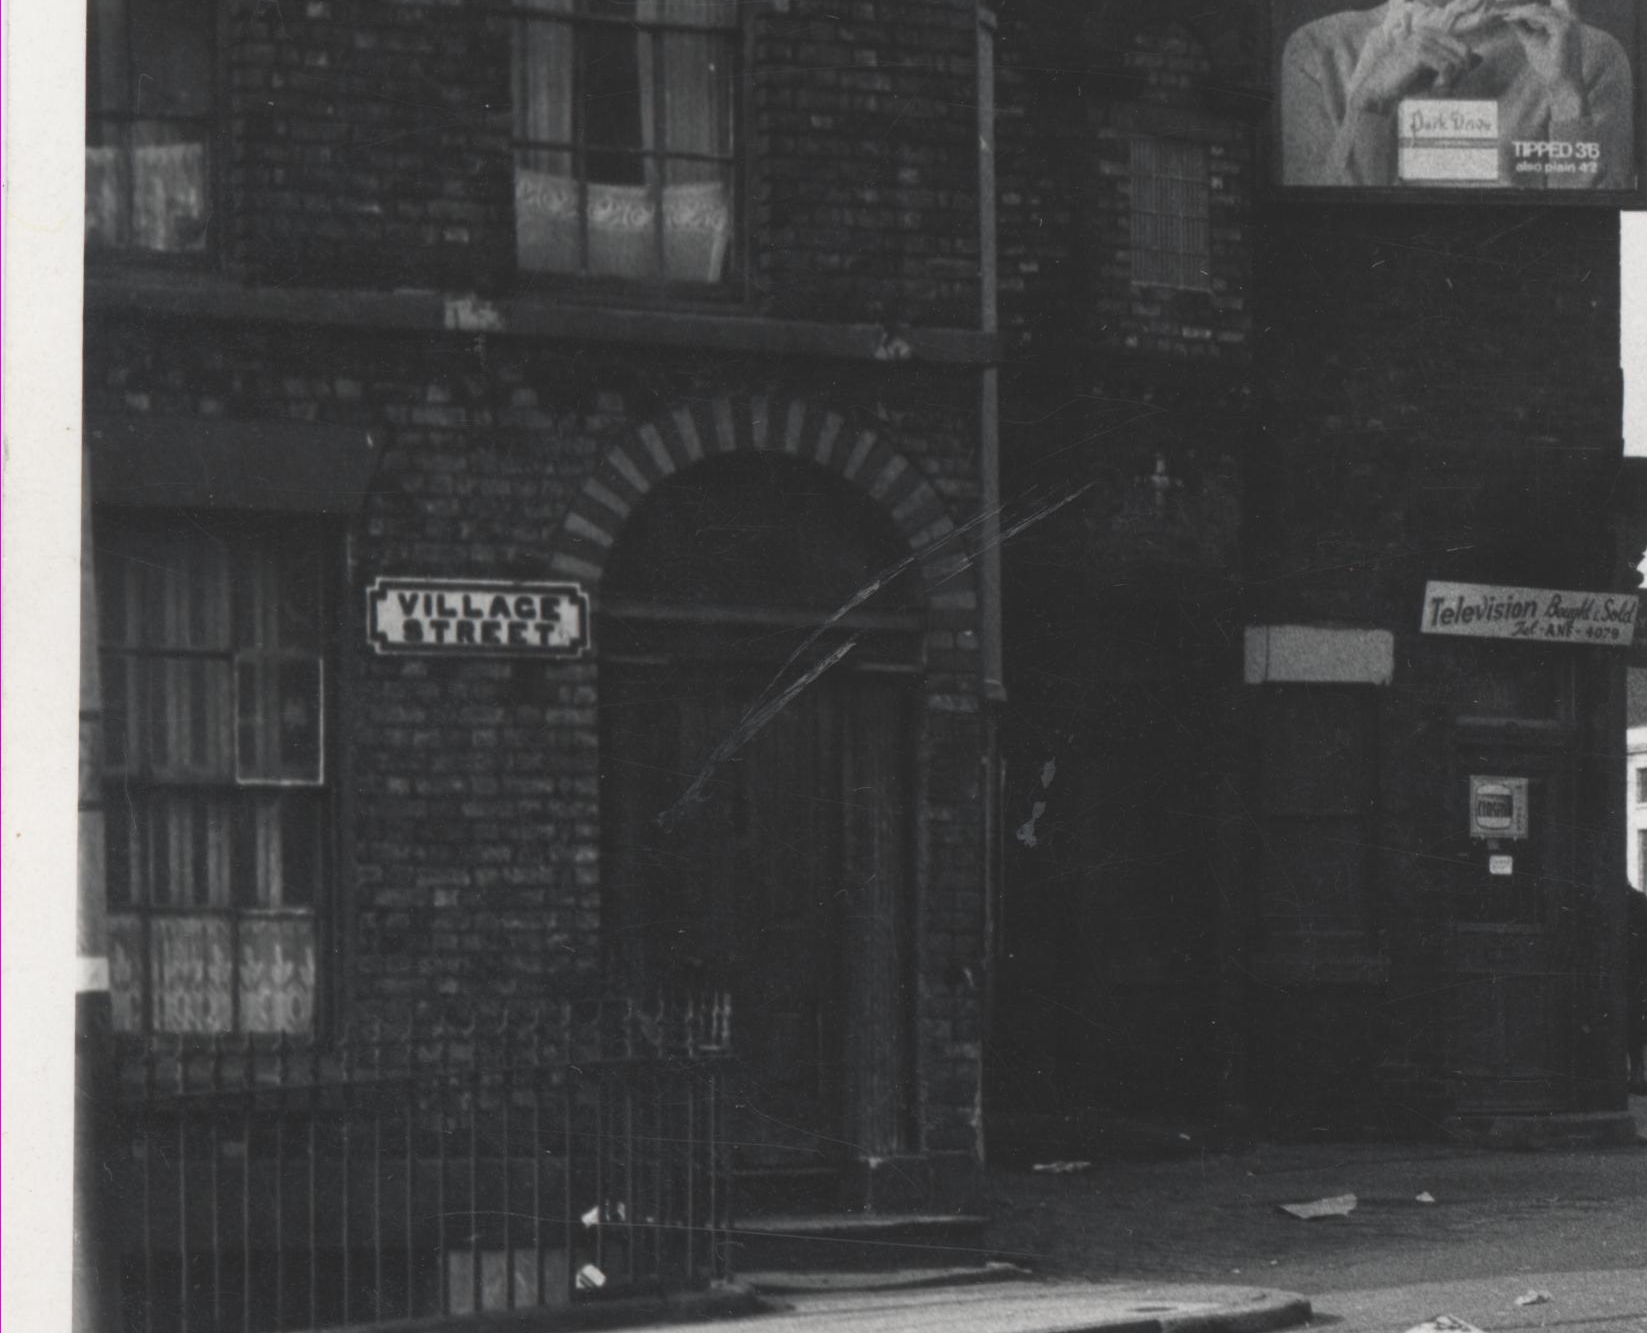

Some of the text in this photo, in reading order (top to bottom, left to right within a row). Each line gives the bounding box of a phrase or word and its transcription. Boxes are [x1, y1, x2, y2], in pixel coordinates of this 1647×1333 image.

[1511, 141, 1574, 158] TIPPED
[398, 592, 562, 622] VILLAGE
[1431, 593, 1539, 627] Television
[1600, 598, 1637, 625] Sold
[402, 619, 556, 646] STREET
